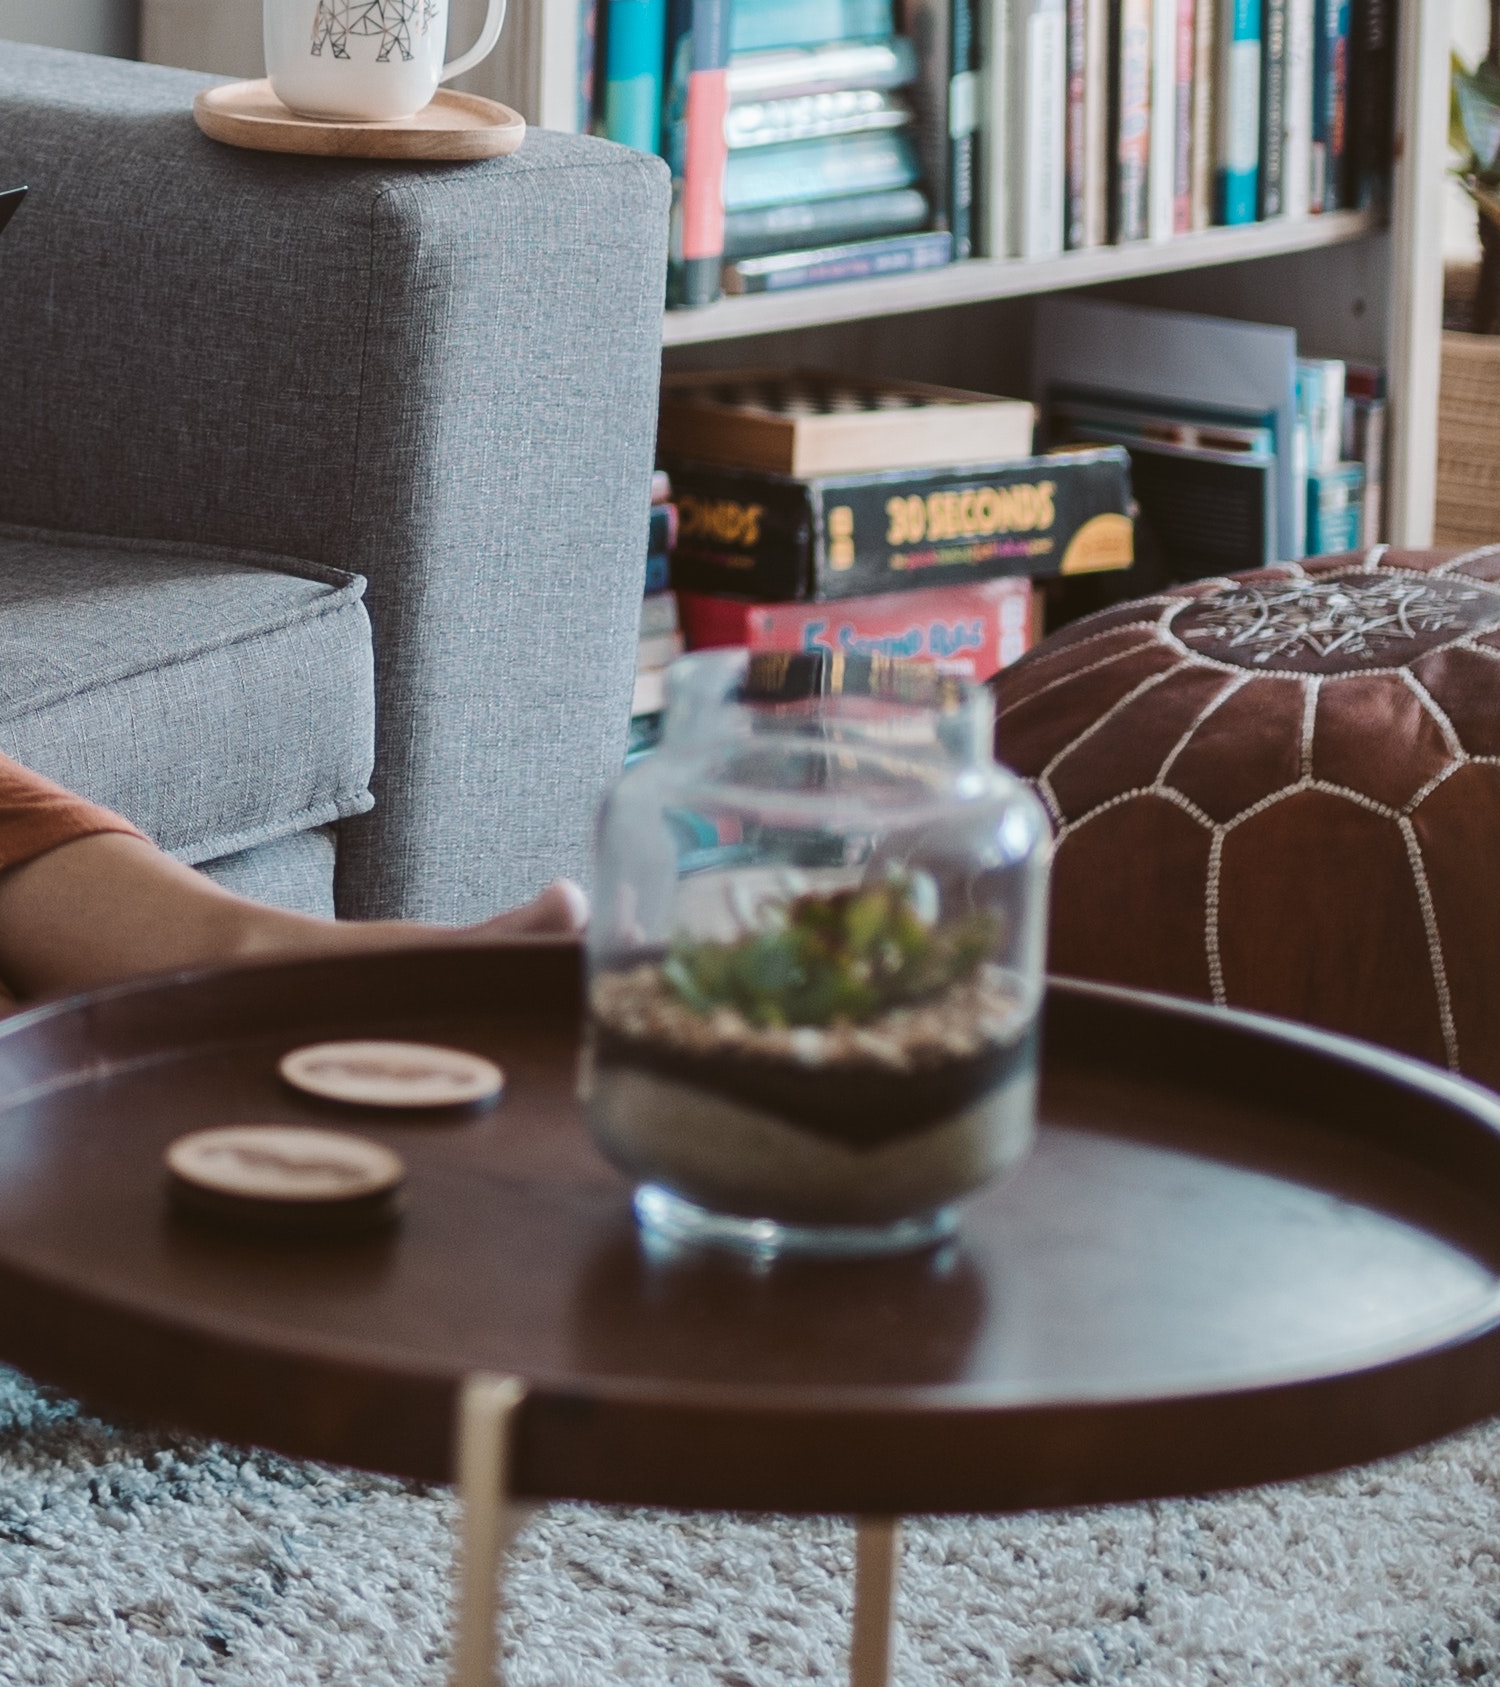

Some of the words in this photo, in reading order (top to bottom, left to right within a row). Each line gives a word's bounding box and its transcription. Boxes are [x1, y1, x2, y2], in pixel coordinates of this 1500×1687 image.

[679, 496, 764, 546] ONDS
[885, 493, 926, 546] 30
[928, 482, 1055, 541] SECONDS
